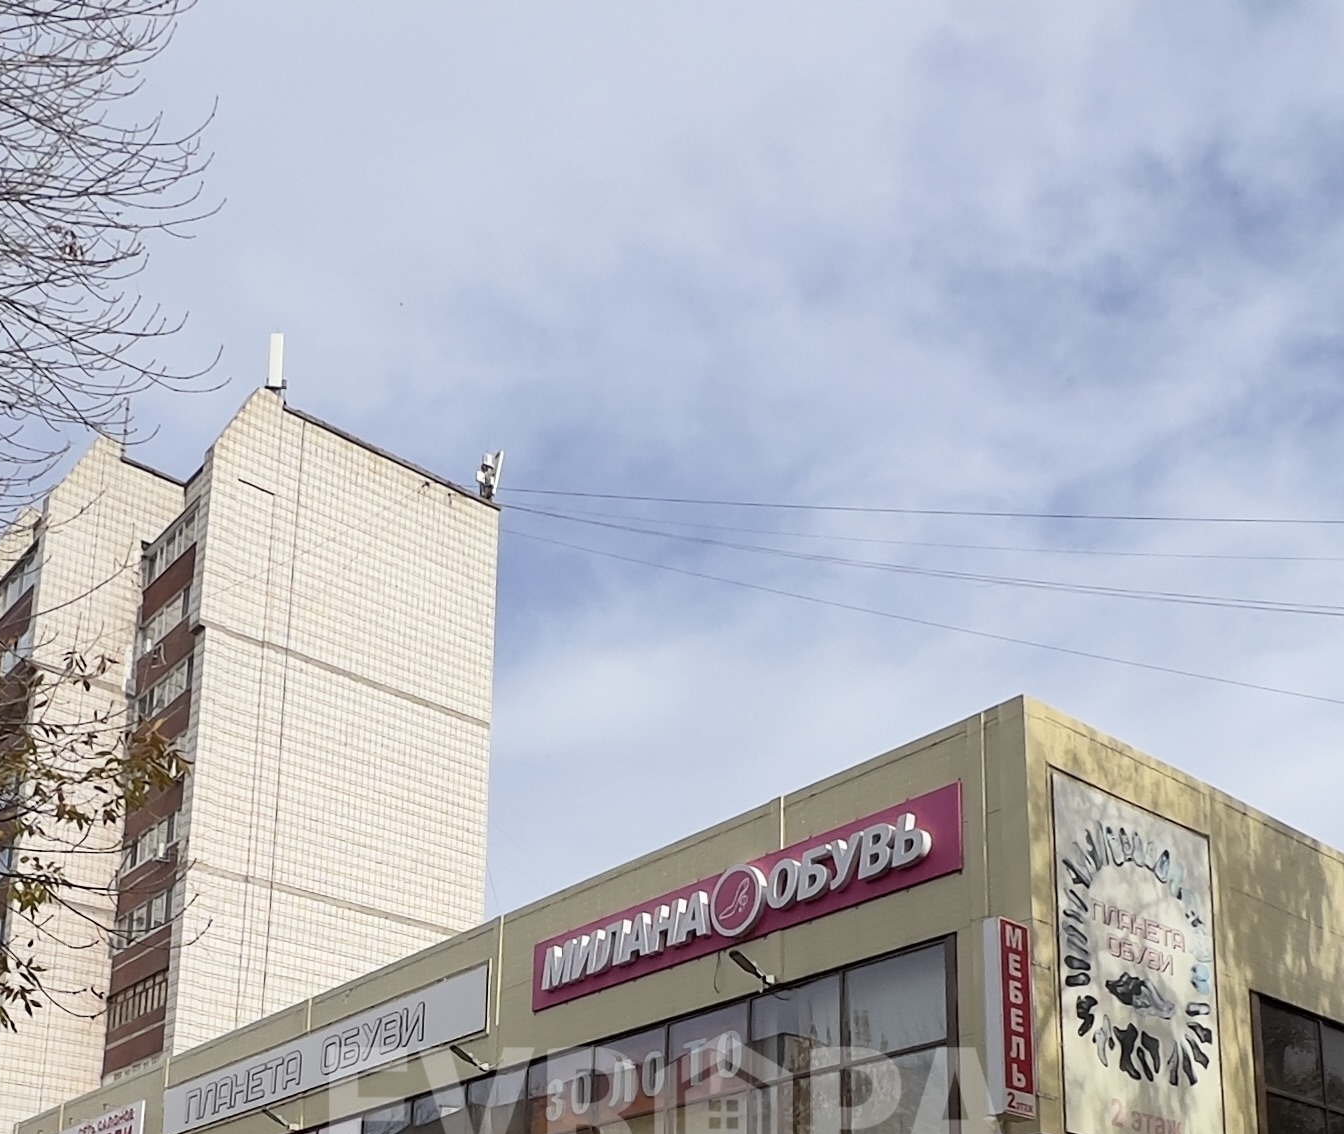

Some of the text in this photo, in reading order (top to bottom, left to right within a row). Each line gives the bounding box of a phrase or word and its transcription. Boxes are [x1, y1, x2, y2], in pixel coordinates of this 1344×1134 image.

[542, 812, 932, 991] МИЛАНА ОБУВЬ
[1091, 898, 1185, 953] ПЛАНЕТА
[1107, 933, 1174, 976] ОБУВИ
[1006, 925, 1026, 1088] МЕБЕЛЬ
[185, 1002, 425, 1124] ПЛАНЕТА ОБУВИ
[546, 1030, 742, 1121] ЗОЛОТО
[1007, 1092, 1016, 1109] 2
[1111, 1098, 1124, 1128] 2
